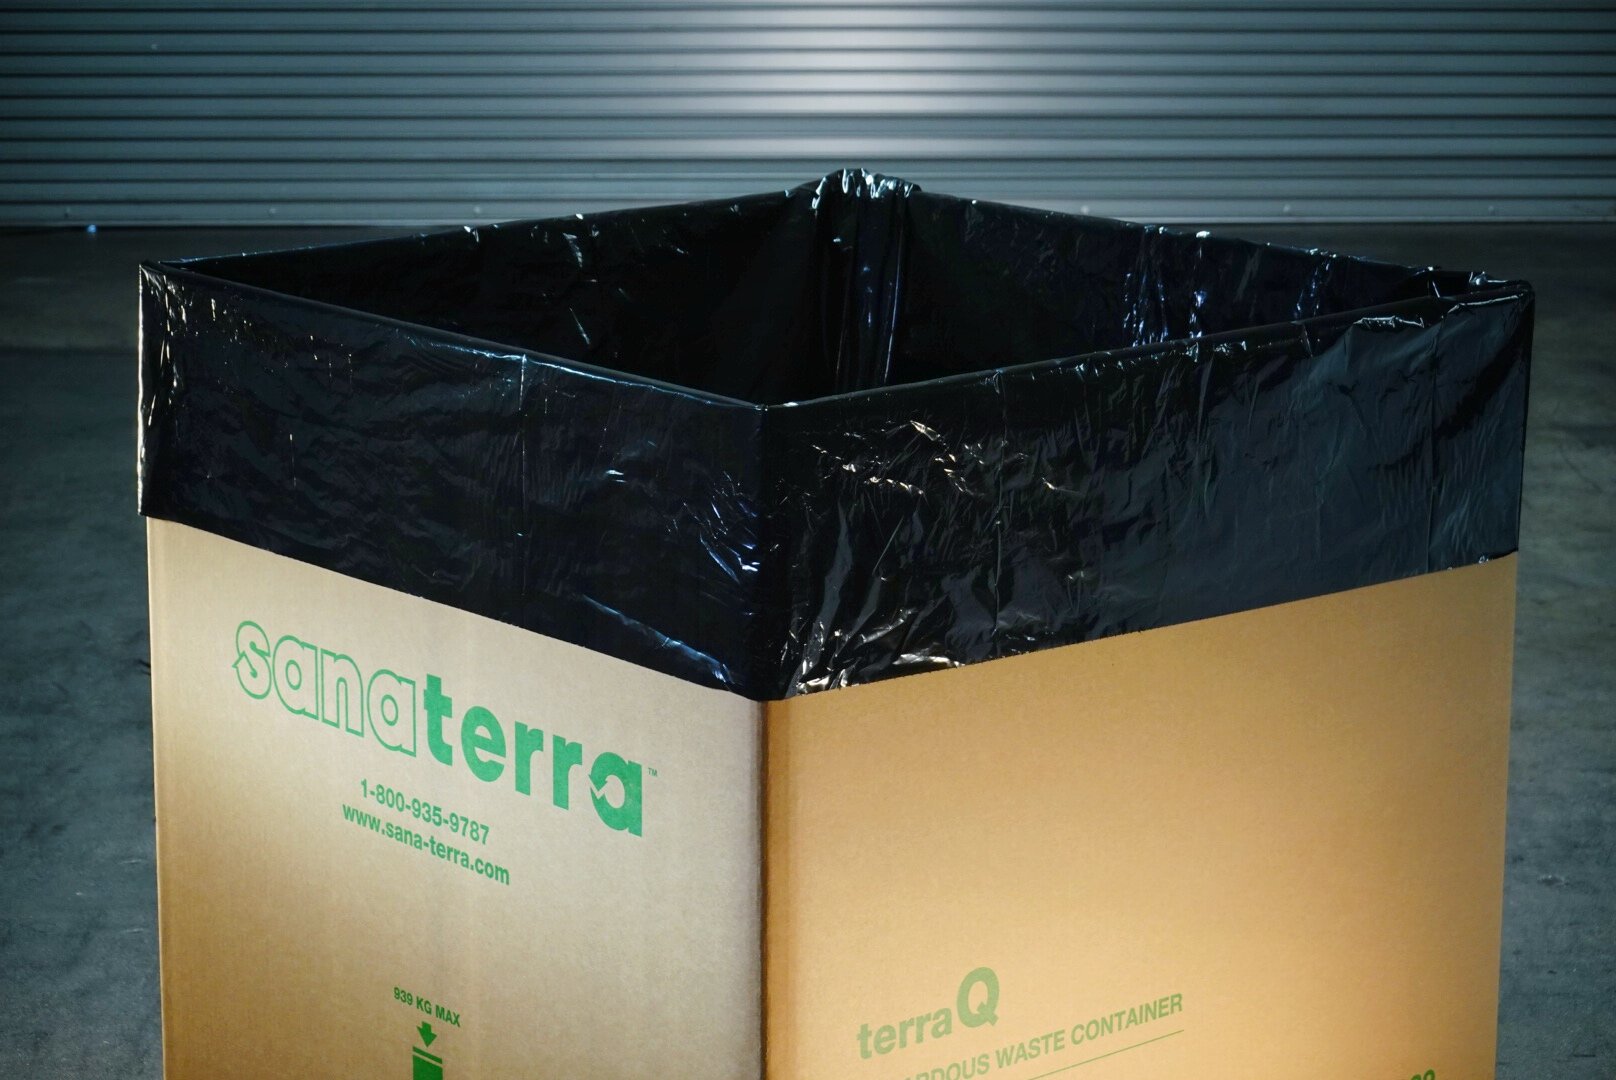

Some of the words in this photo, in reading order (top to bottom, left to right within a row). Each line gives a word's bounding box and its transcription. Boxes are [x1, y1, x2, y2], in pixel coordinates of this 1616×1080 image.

[232, 620, 643, 837] sanaterra
[342, 803, 510, 885] www.sana-terra.com
[360, 778, 490, 844] 1-800-935-9787
[393, 986, 413, 1006] 939
[416, 995, 432, 1015] KG
[435, 1004, 461, 1028] MAX
[995, 1029, 1066, 1069] WASTE
[1070, 993, 1183, 1046] CONTAINER
